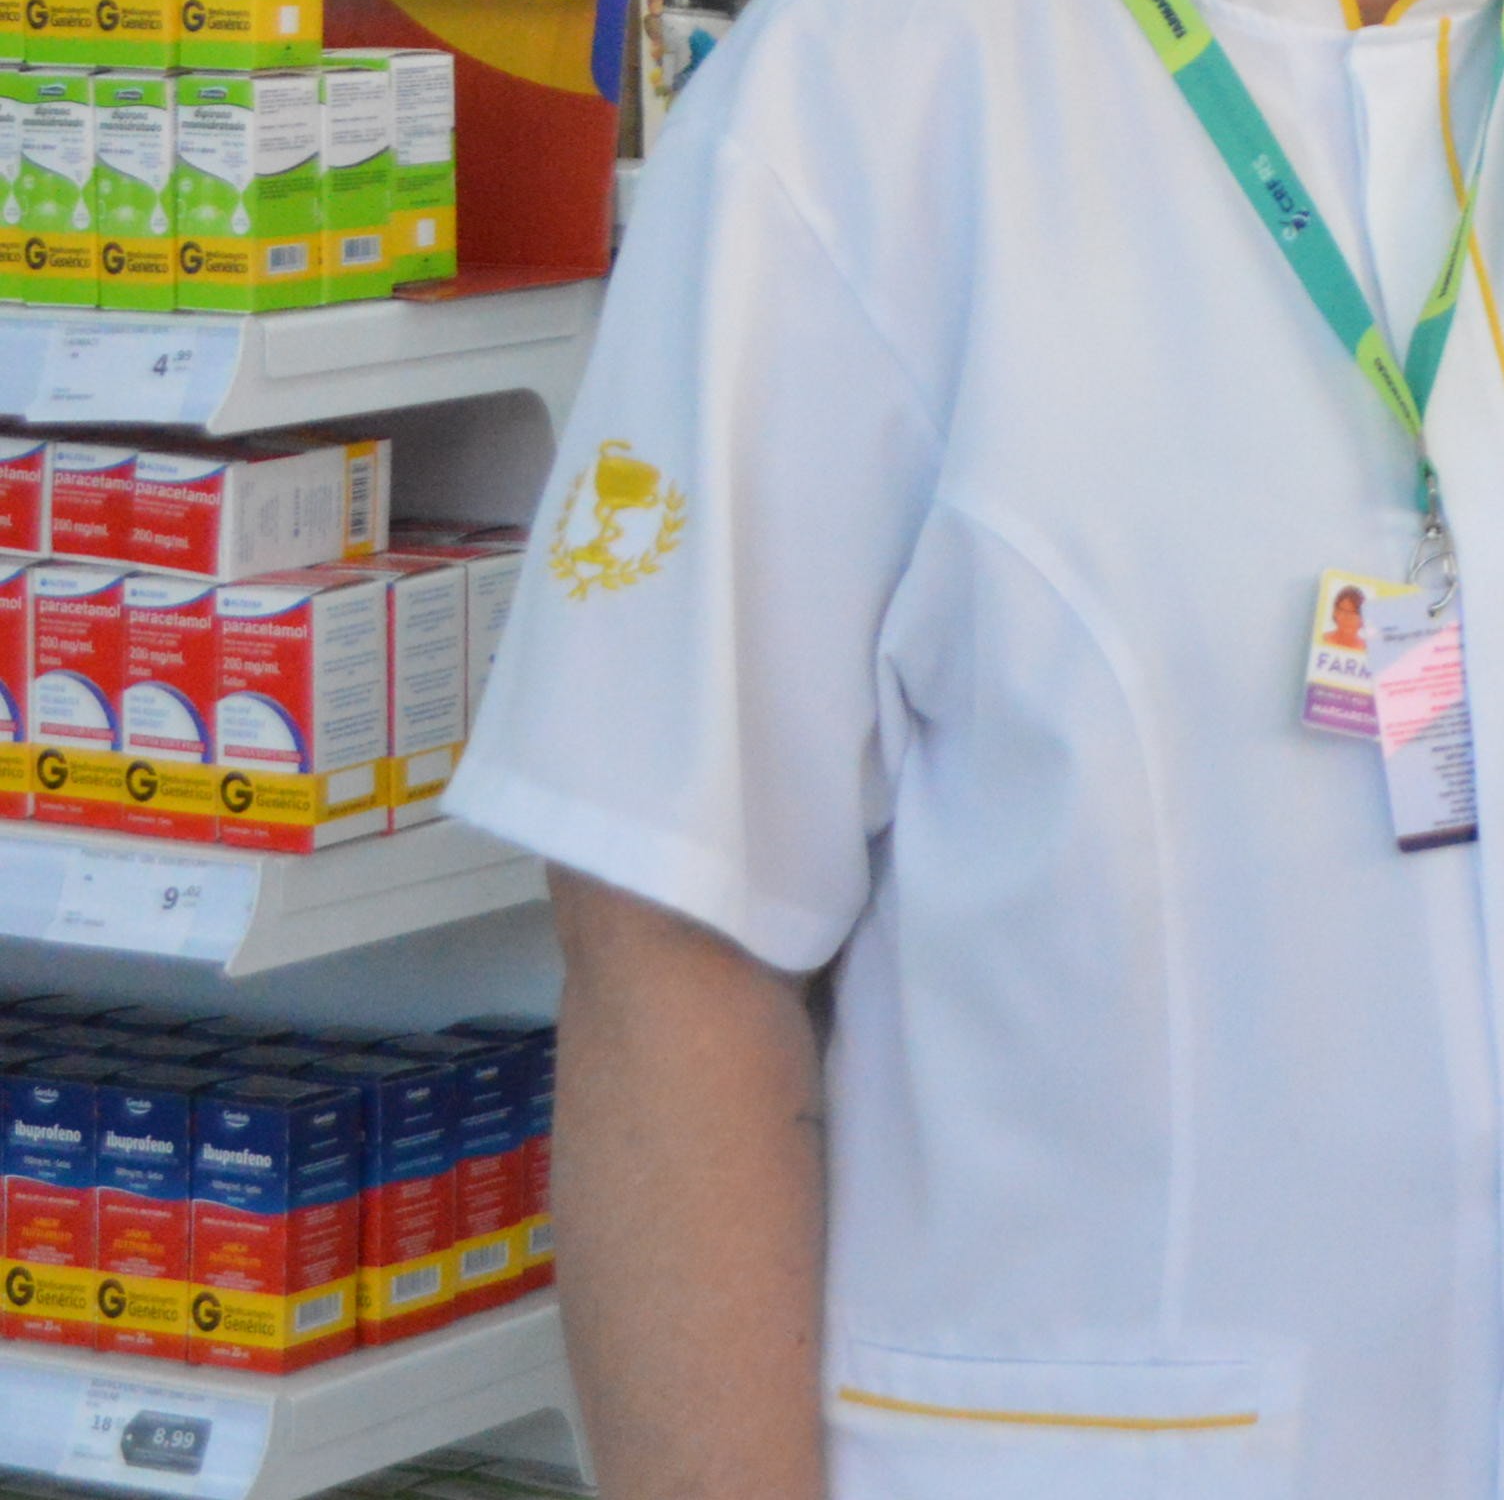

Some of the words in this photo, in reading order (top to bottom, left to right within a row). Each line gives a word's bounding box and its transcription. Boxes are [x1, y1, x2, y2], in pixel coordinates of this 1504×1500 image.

[97, 0, 119, 31] G
[183, 0, 205, 31] G
[25, 238, 47, 270] G
[103, 243, 125, 274] G
[180, 241, 203, 274] G
[55, 472, 133, 491] paracetamo
[135, 482, 220, 505] paracetamol
[40, 599, 120, 620] paracetamol
[130, 610, 211, 630] paracetamol
[223, 620, 307, 640] paracetamol
[37, 749, 68, 789] G
[126, 761, 158, 801] G
[220, 772, 253, 813] G
[15, 1120, 81, 1144] ibuprofeno
[106, 1131, 174, 1154] ibuprofeno
[203, 1144, 272, 1168] ibuprofeno
[6, 1267, 34, 1306] G
[98, 1279, 126, 1318] G
[192, 1292, 221, 1331] G
